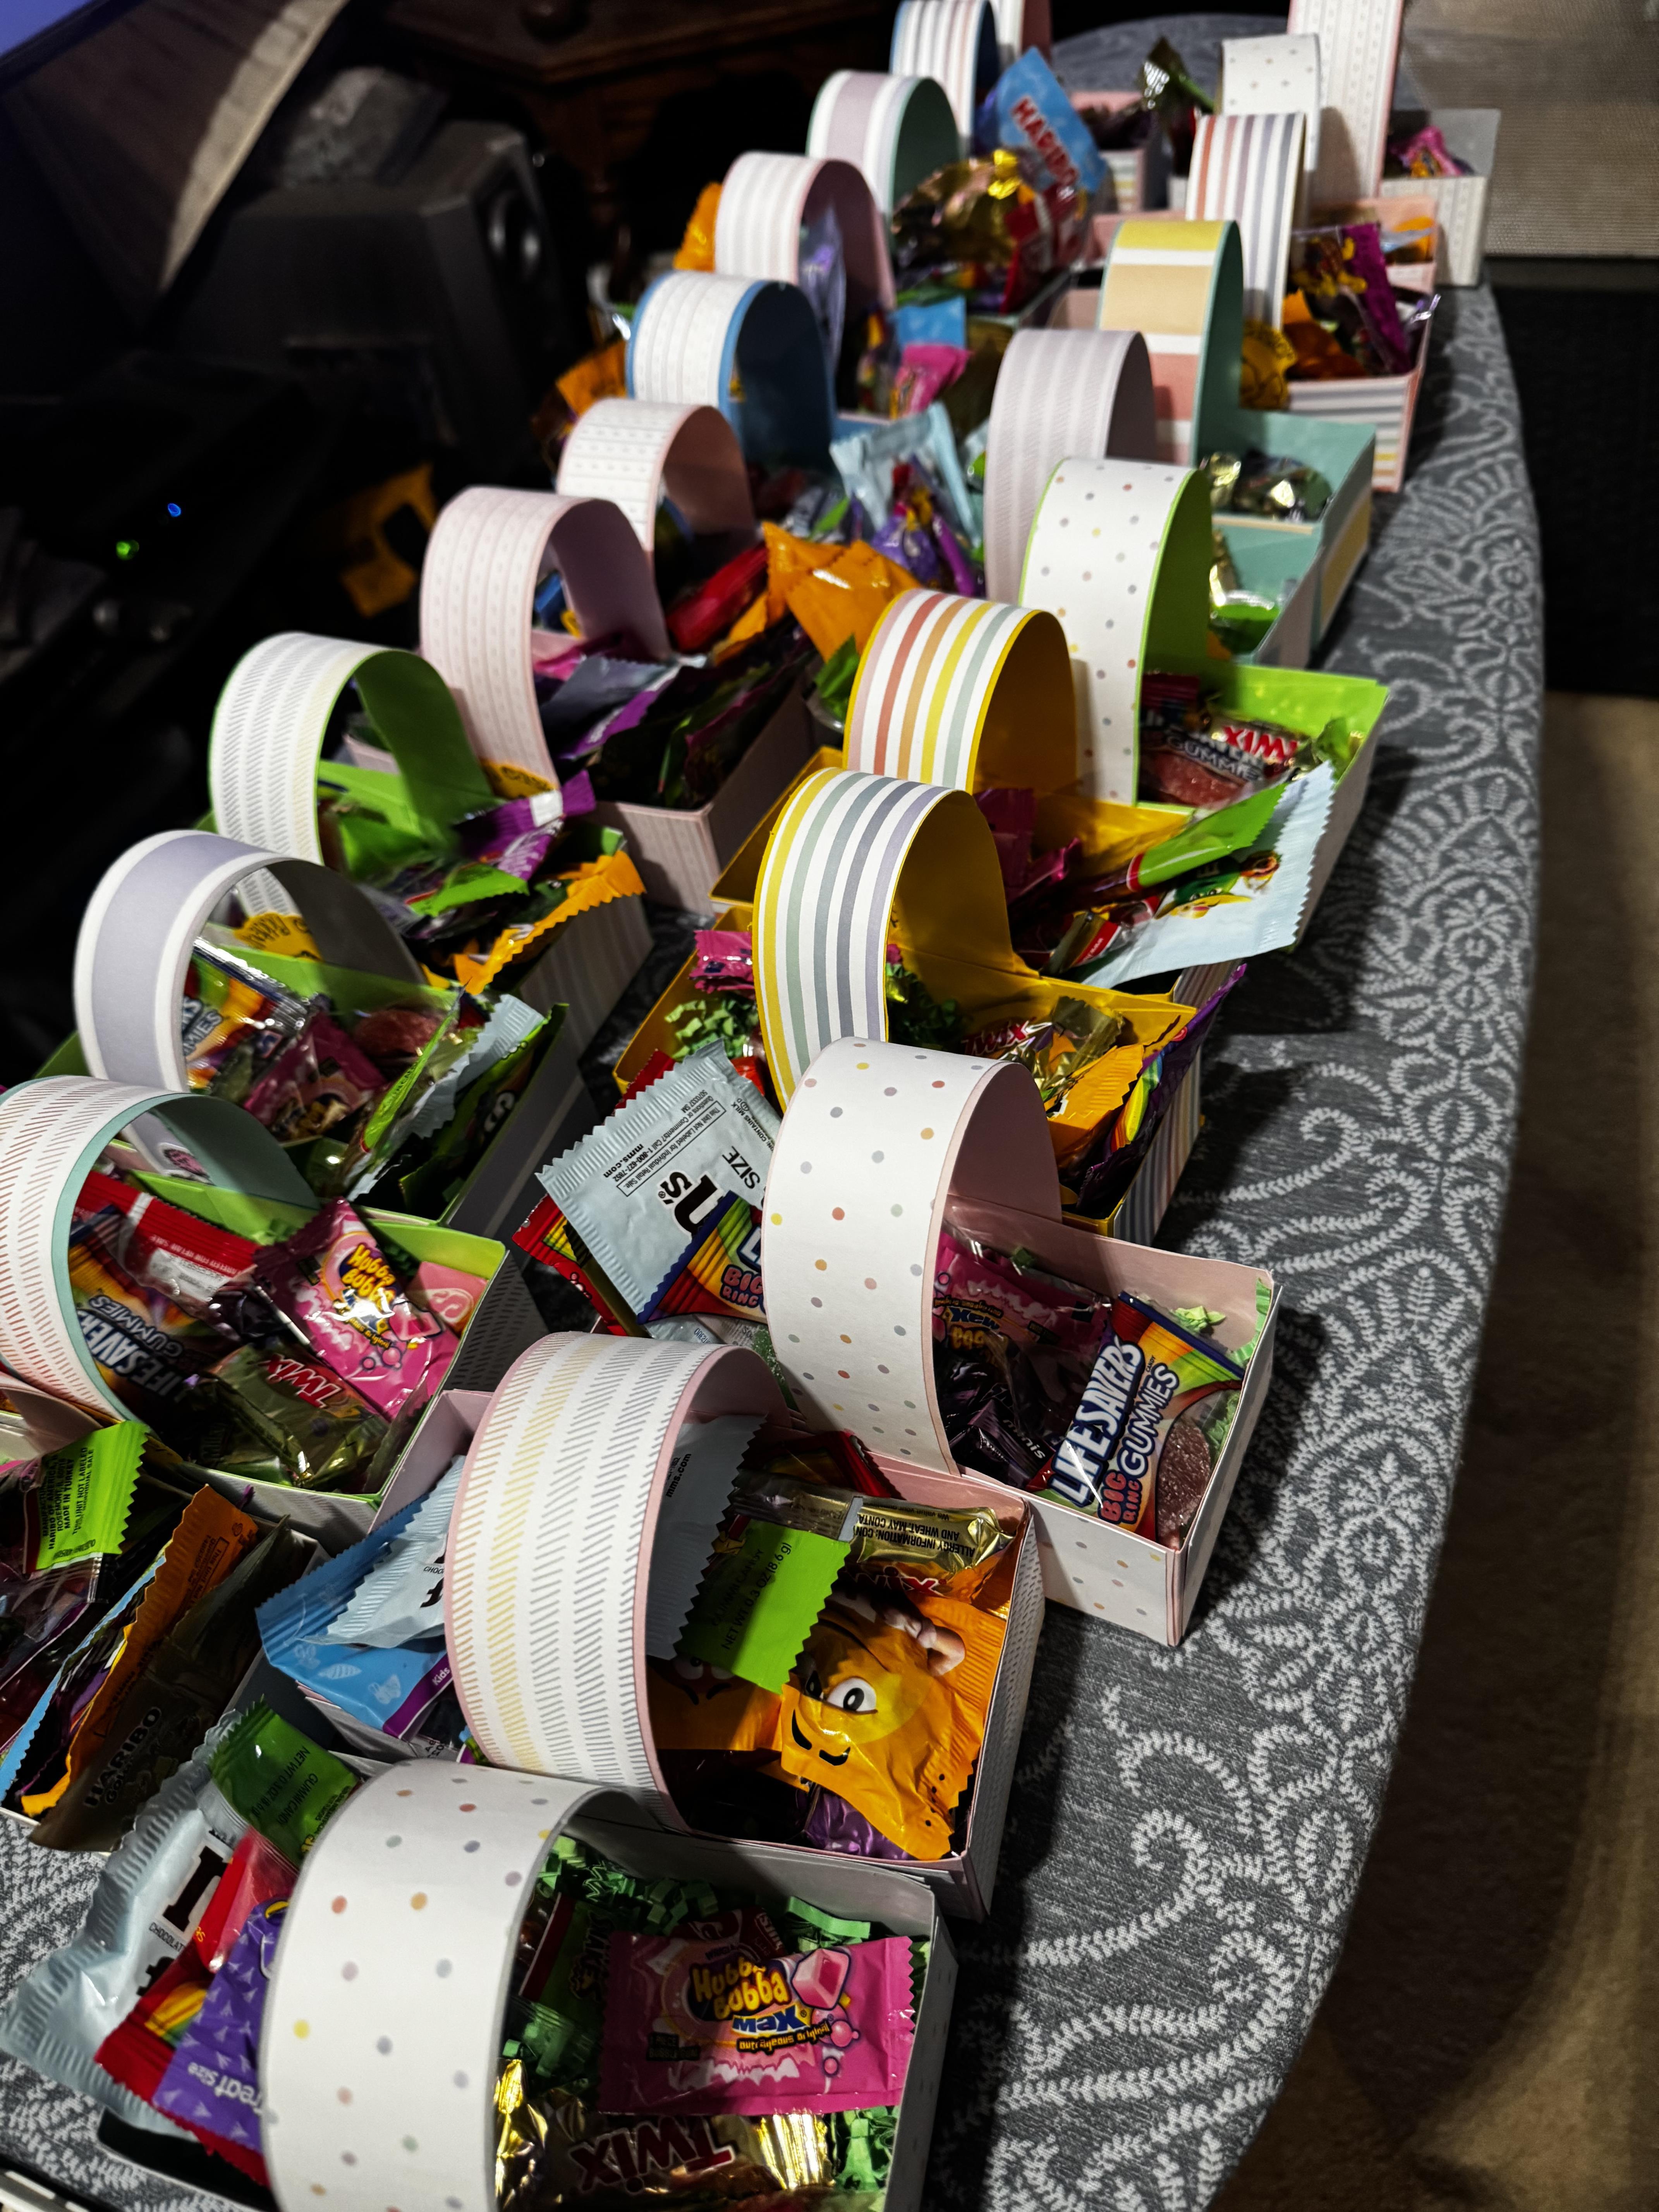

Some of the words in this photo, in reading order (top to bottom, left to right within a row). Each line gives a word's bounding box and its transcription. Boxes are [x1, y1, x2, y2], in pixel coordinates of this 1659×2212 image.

[692, 1094, 714, 1115] Questions
[731, 1101, 745, 1116] MILK
[660, 1116, 689, 1142] Comments?
[675, 1127, 696, 1146] Labeled
[693, 1120, 704, 1131] Not
[743, 1115, 768, 1142] CONTAINS
[651, 1139, 663, 1151] Call
[669, 1142, 678, 1152] for
[603, 1143, 644, 1180] mms.com
[647, 1148, 672, 1171] Individual
[722, 1146, 760, 1189] SIZE
[623, 1177, 638, 1191] Sale.
[635, 1166, 651, 1181] Retail
[347, 1242, 396, 1285] Hubba
[722, 1285, 759, 1308] RING
[91, 1297, 182, 1359] GUMMIES
[1144, 1355, 1157, 1372] CANDY
[1118, 1364, 1177, 1472] GUMMIES
[1002, 1418, 1046, 1460] minis
[64, 1459, 73, 1491] TURKEY
[78, 1447, 87, 1481] LABELED
[665, 1451, 692, 1499] mms.com
[62, 1494, 70, 1503] IN
[1101, 1473, 1126, 1522] BIG
[1121, 1482, 1139, 1520] RING
[62, 1505, 70, 1528] MADE
[856, 1513, 886, 1528] CONTA
[886, 1519, 906, 1531] MAY
[874, 1529, 936, 1549] INFORMATION:
[907, 1522, 939, 1537] WHEAT.
[941, 1529, 960, 1541] AND
[938, 1541, 975, 1556] ALLERGY
[721, 1627, 739, 1650] NET
[733, 1608, 749, 1627] WT
[754, 1570, 771, 1590] OZ
[778, 1541, 793, 1555] g)
[431, 1666, 452, 1686] Kids
[291, 1745, 311, 1767] NET
[282, 1760, 299, 1779] WT
[292, 1771, 320, 1805] GUMMI
[692, 1956, 766, 2002] Hubba
[714, 1970, 790, 2020] Bubba
[738, 2033, 795, 2056] outrageous
[794, 2023, 832, 2046] original
[214, 2075, 263, 2116] reat
